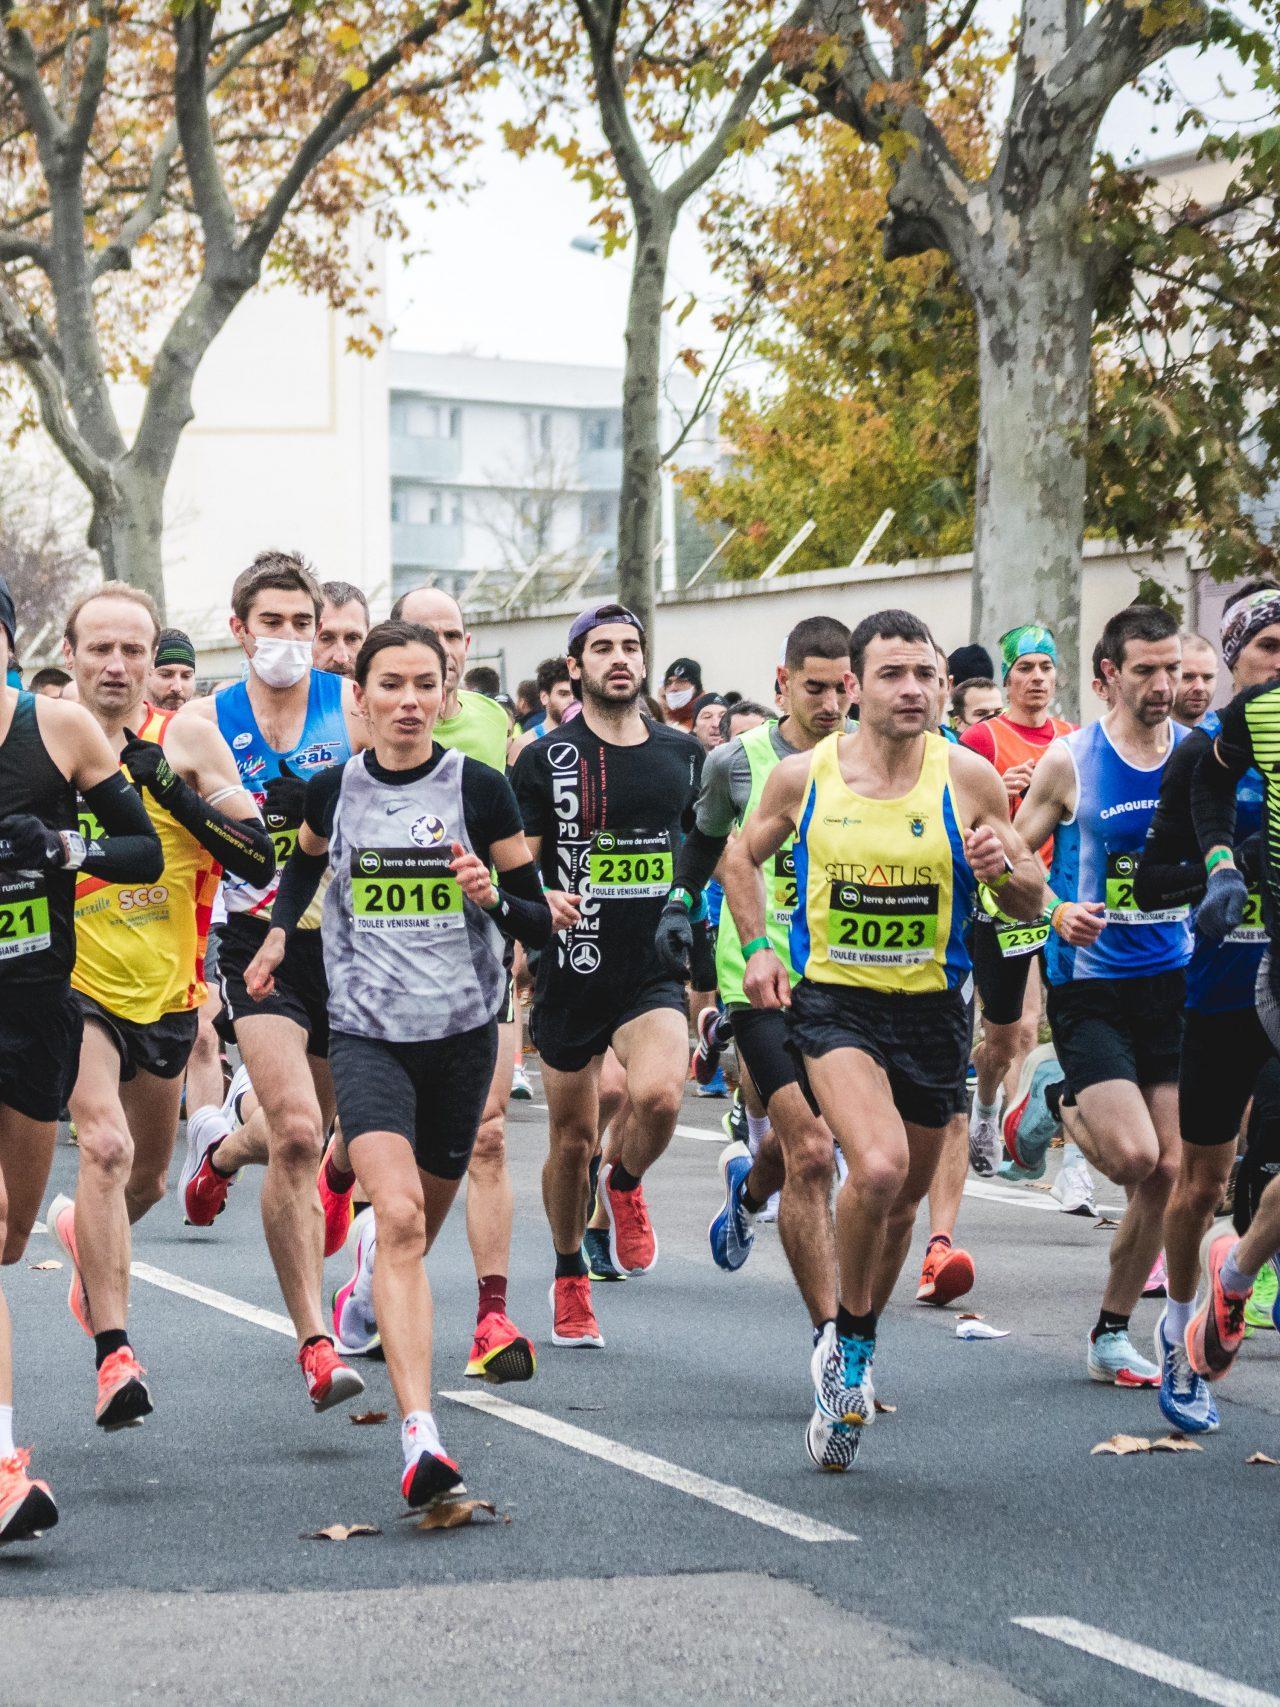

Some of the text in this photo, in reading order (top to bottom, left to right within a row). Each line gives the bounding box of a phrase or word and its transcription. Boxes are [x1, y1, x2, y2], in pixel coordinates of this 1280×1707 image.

[295, 749, 332, 765] eab
[553, 777, 579, 820] 5
[558, 822, 579, 838] PD
[643, 837, 666, 845] running
[383, 858, 403, 867] terre
[405, 858, 416, 867] de
[418, 857, 450, 868] running
[599, 858, 665, 883] 2303
[1, 880, 35, 892] running
[118, 886, 169, 910] SCO
[365, 883, 451, 912] 2016
[863, 895, 883, 904] terre
[885, 896, 896, 904] de
[897, 894, 929, 905] running
[839, 918, 925, 948] 2023
[1006, 929, 1048, 947] 230
